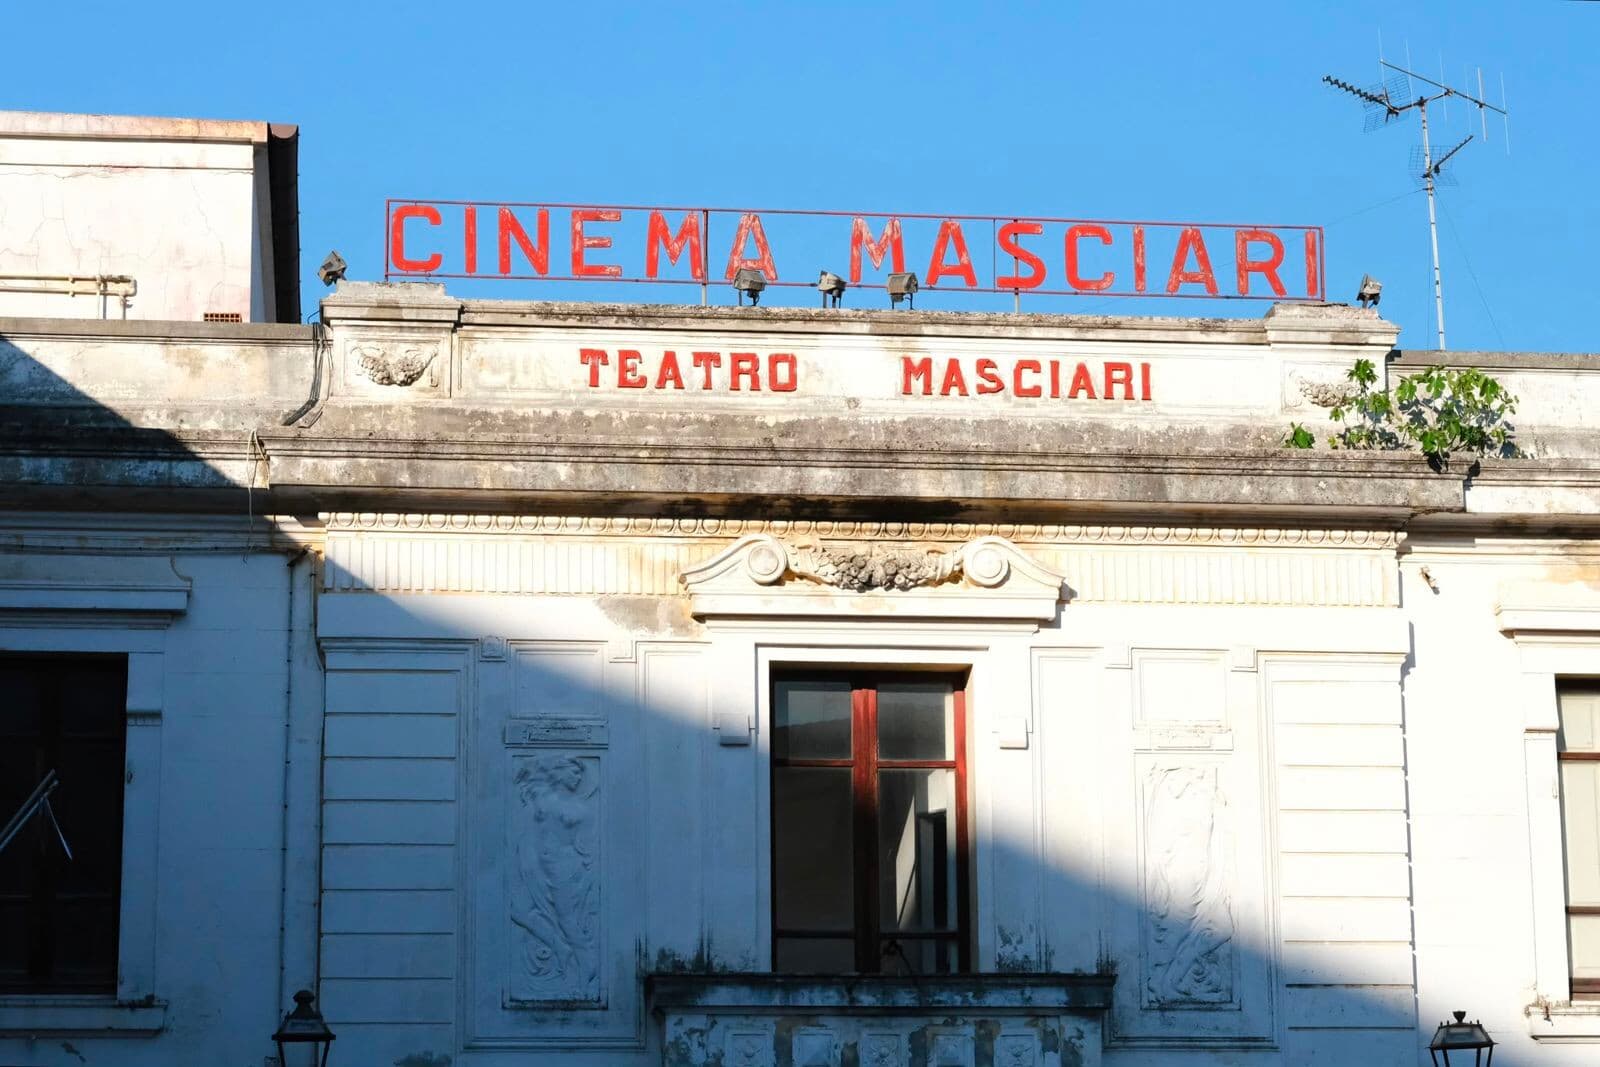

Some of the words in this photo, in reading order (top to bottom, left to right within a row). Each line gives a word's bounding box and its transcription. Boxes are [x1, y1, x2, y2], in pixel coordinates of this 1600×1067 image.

[391, 205, 778, 282] CINEMA
[849, 216, 1318, 297] MASCIARI
[580, 348, 798, 393] TEATRO
[902, 356, 1152, 401] MASCIARI
